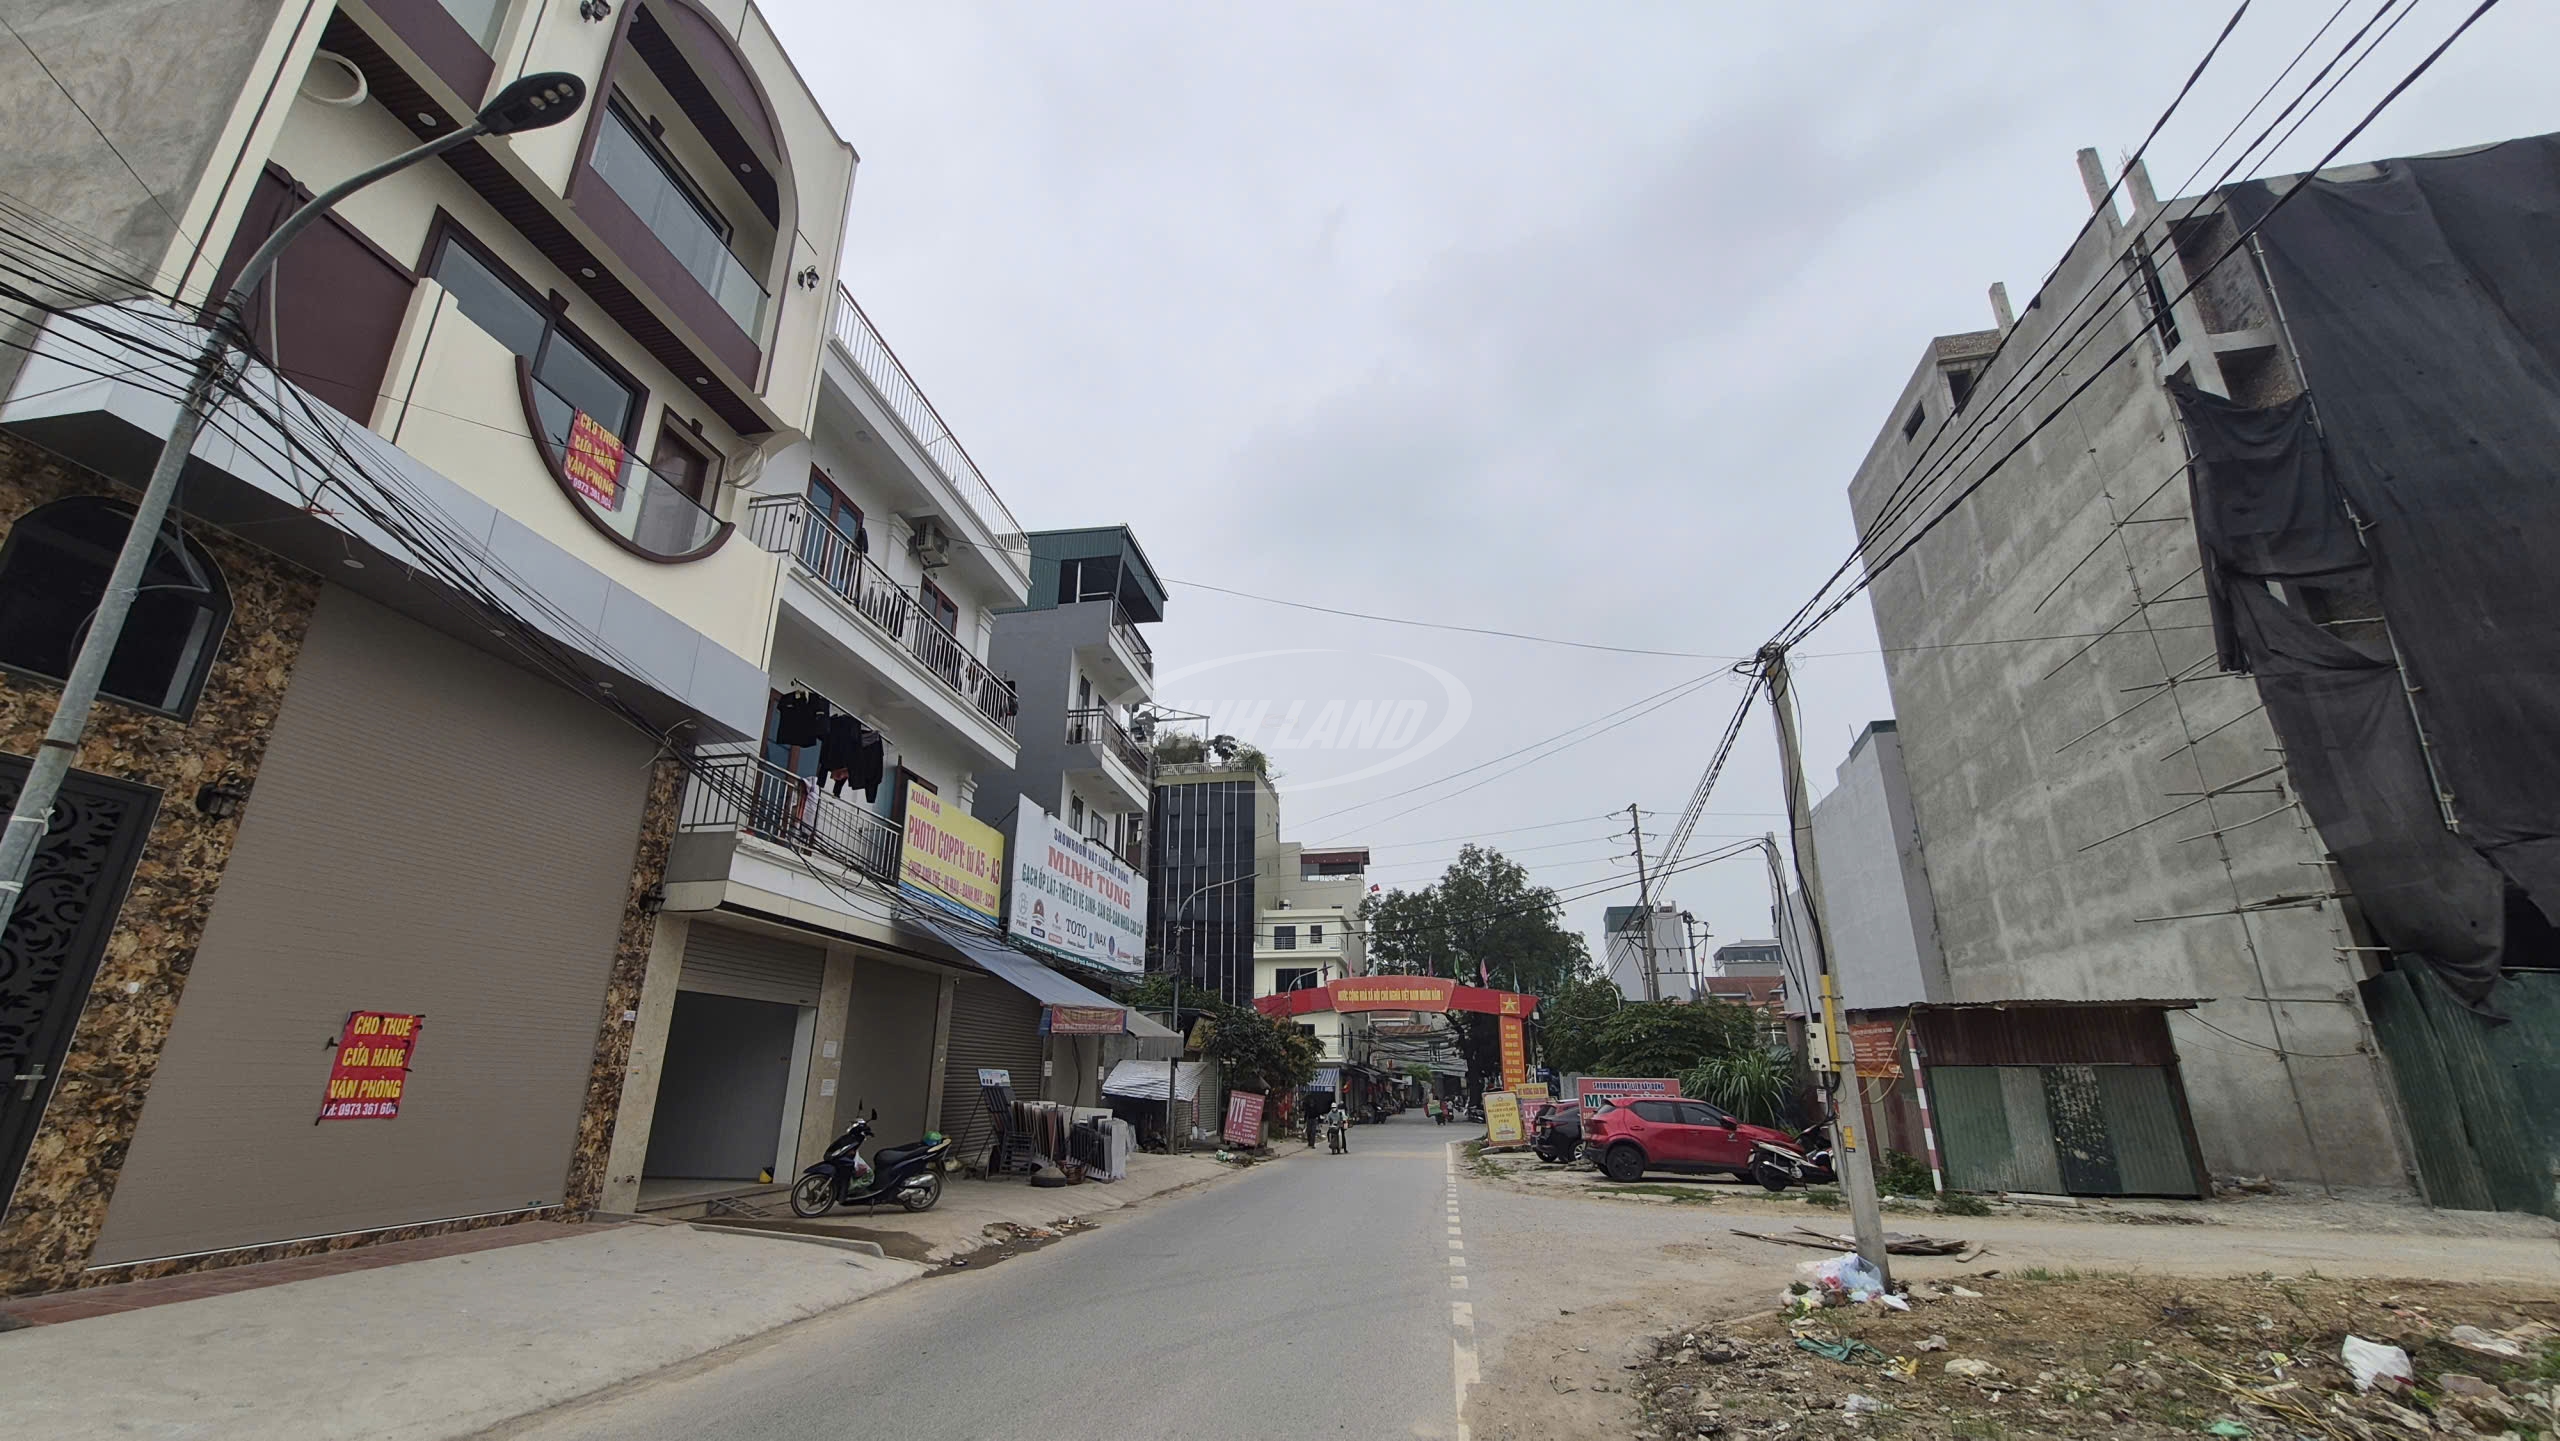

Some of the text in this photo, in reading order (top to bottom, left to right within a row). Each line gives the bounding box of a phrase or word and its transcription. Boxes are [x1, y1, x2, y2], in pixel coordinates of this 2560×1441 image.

[580, 413, 598, 436] CHO
[594, 446, 616, 474] HÀNG
[586, 467, 614, 496] PHÒNG
[912, 789, 940, 818] XUÂN HẠ
[907, 814, 937, 855] PHOTO
[975, 850, 985, 878] A5
[990, 858, 1000, 884] A3
[1054, 828, 1087, 858] SHOWROOM
[1022, 863, 1038, 890] GẠCH
[1039, 866, 1046, 891] ỐP
[1048, 845, 1131, 910] MINH TÙNG
[1066, 918, 1087, 938] TOTO
[354, 1016, 414, 1036] CHO THUÊ
[342, 1042, 405, 1067] CỬA HÀNG
[330, 1076, 402, 1098] VĂN PHÒNG
[338, 1104, 361, 1116] 0973
